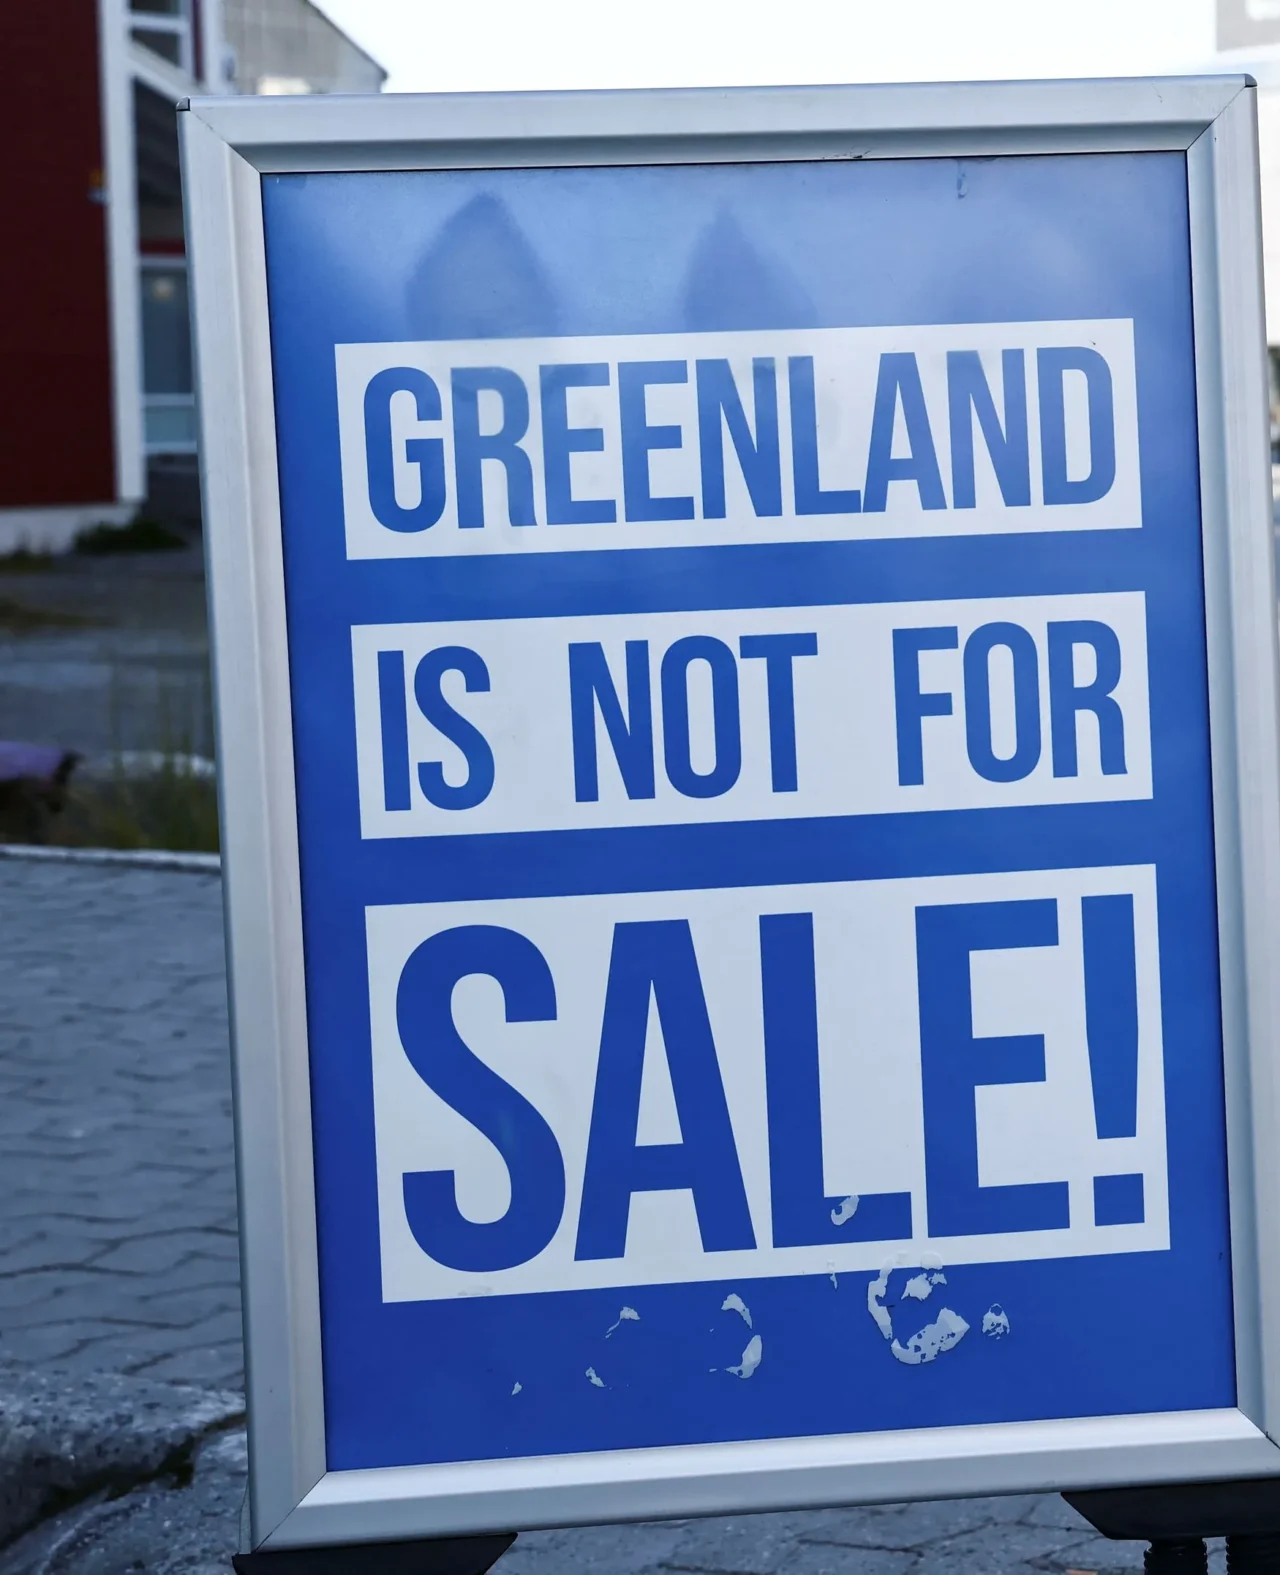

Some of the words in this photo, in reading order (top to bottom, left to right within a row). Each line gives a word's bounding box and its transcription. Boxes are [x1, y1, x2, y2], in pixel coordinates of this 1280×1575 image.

[364, 347, 1115, 532] GREENLAND
[378, 646, 494, 811] IS
[568, 633, 817, 801] NOT
[892, 620, 1127, 785] FOR
[396, 894, 1144, 1272] SALE!
